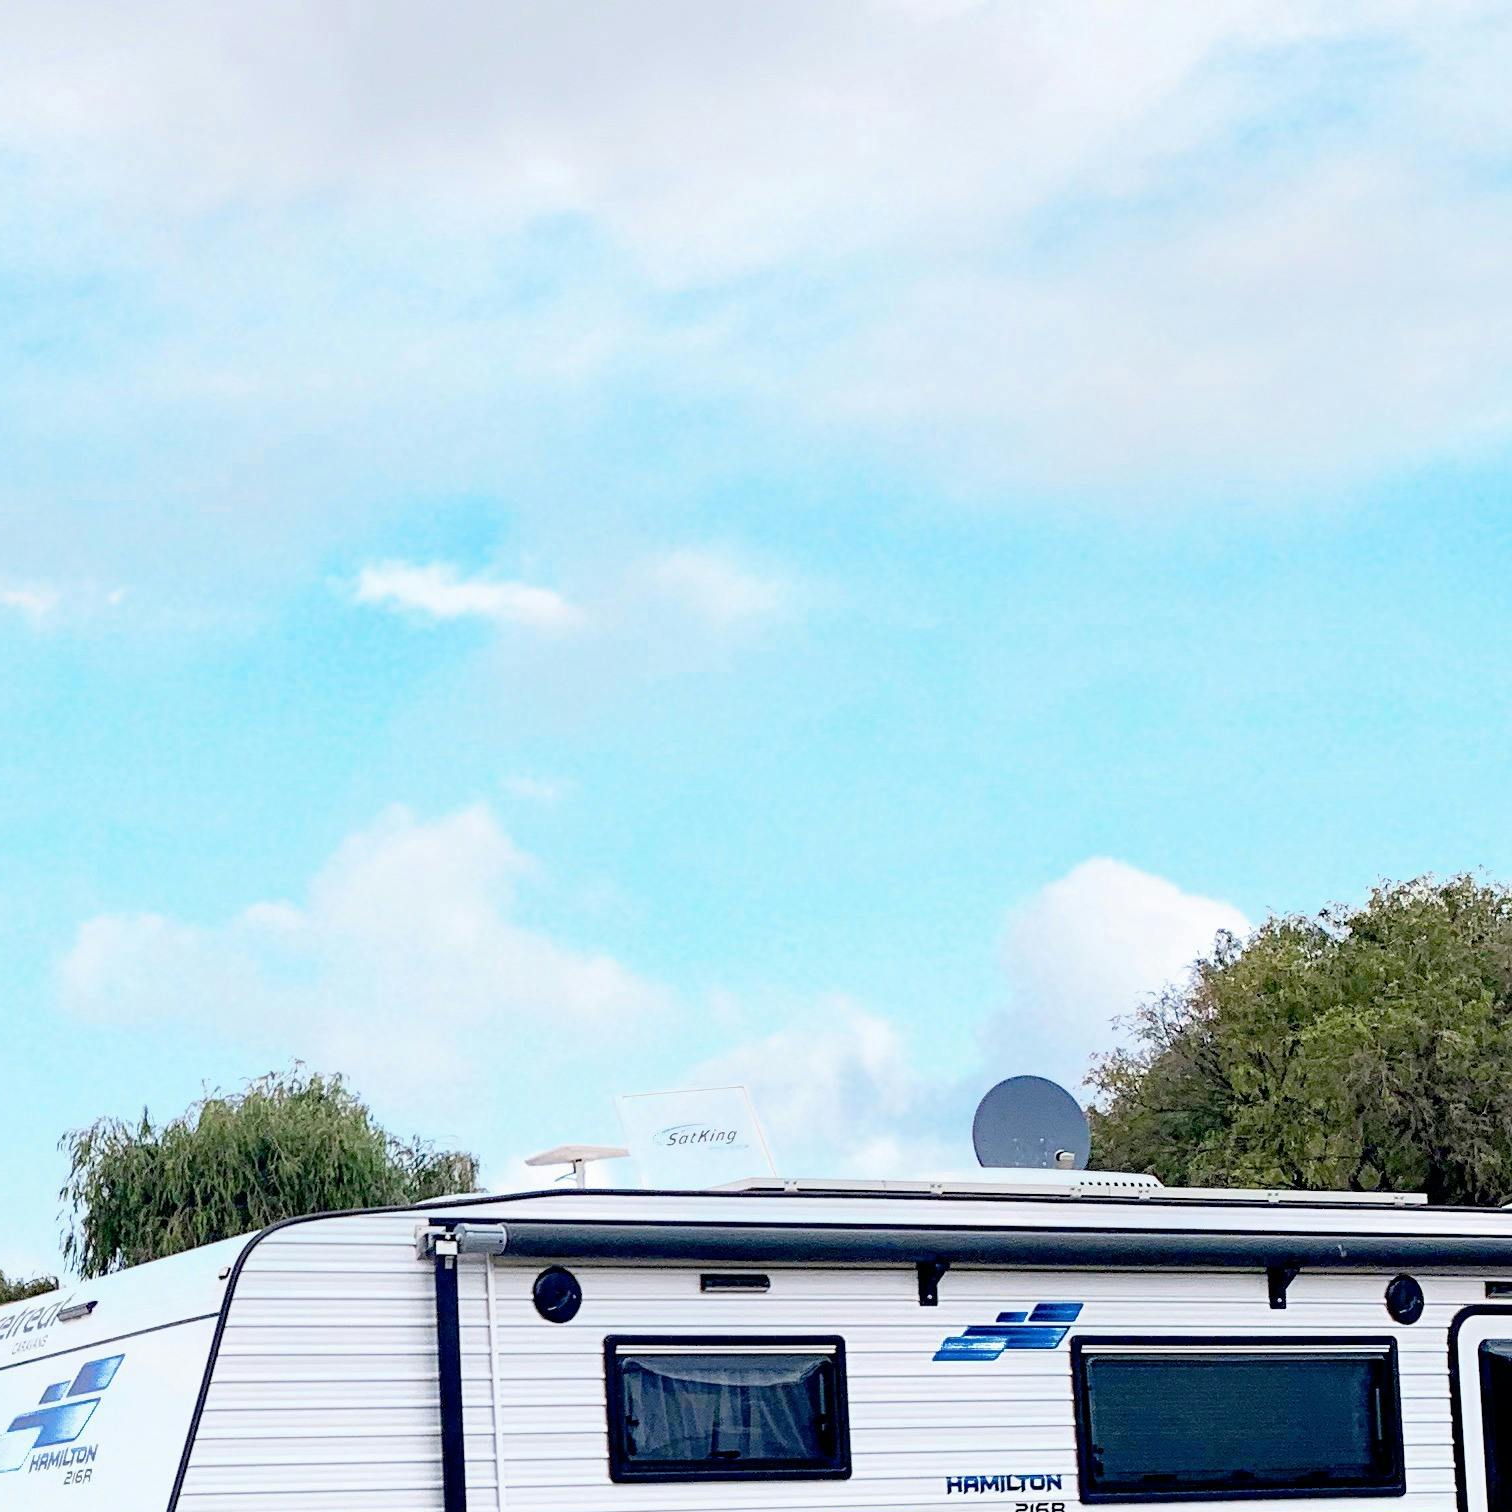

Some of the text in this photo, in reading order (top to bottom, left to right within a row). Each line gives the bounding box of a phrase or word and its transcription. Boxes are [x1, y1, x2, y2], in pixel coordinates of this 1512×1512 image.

[666, 1129, 738, 1146] SatKing
[28, 1443, 99, 1474] HAMILTON
[63, 1468, 94, 1486] 216R
[945, 1473, 1063, 1495] HAMILTON
